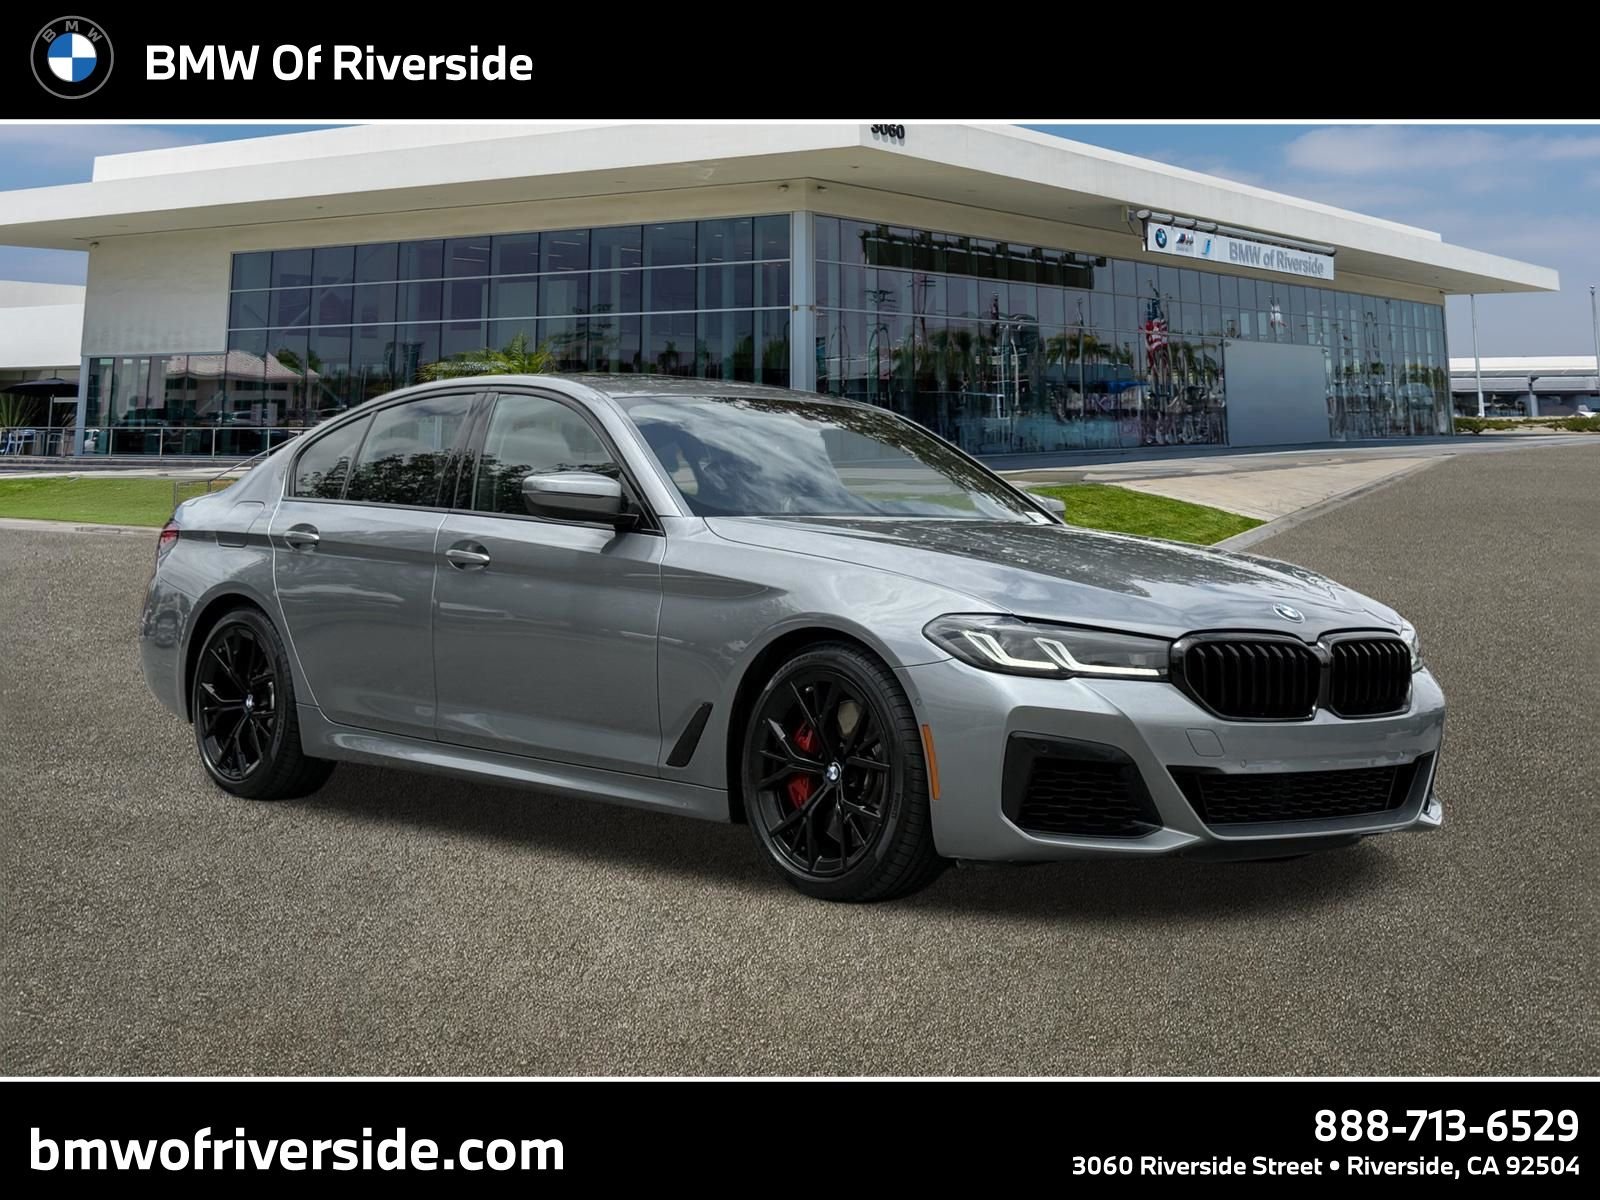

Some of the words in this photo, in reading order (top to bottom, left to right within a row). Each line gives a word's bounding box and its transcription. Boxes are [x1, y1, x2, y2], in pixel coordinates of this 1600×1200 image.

[1229, 241, 1261, 265] BMW
[1263, 249, 1275, 268] of
[1276, 250, 1324, 275] Riverside
